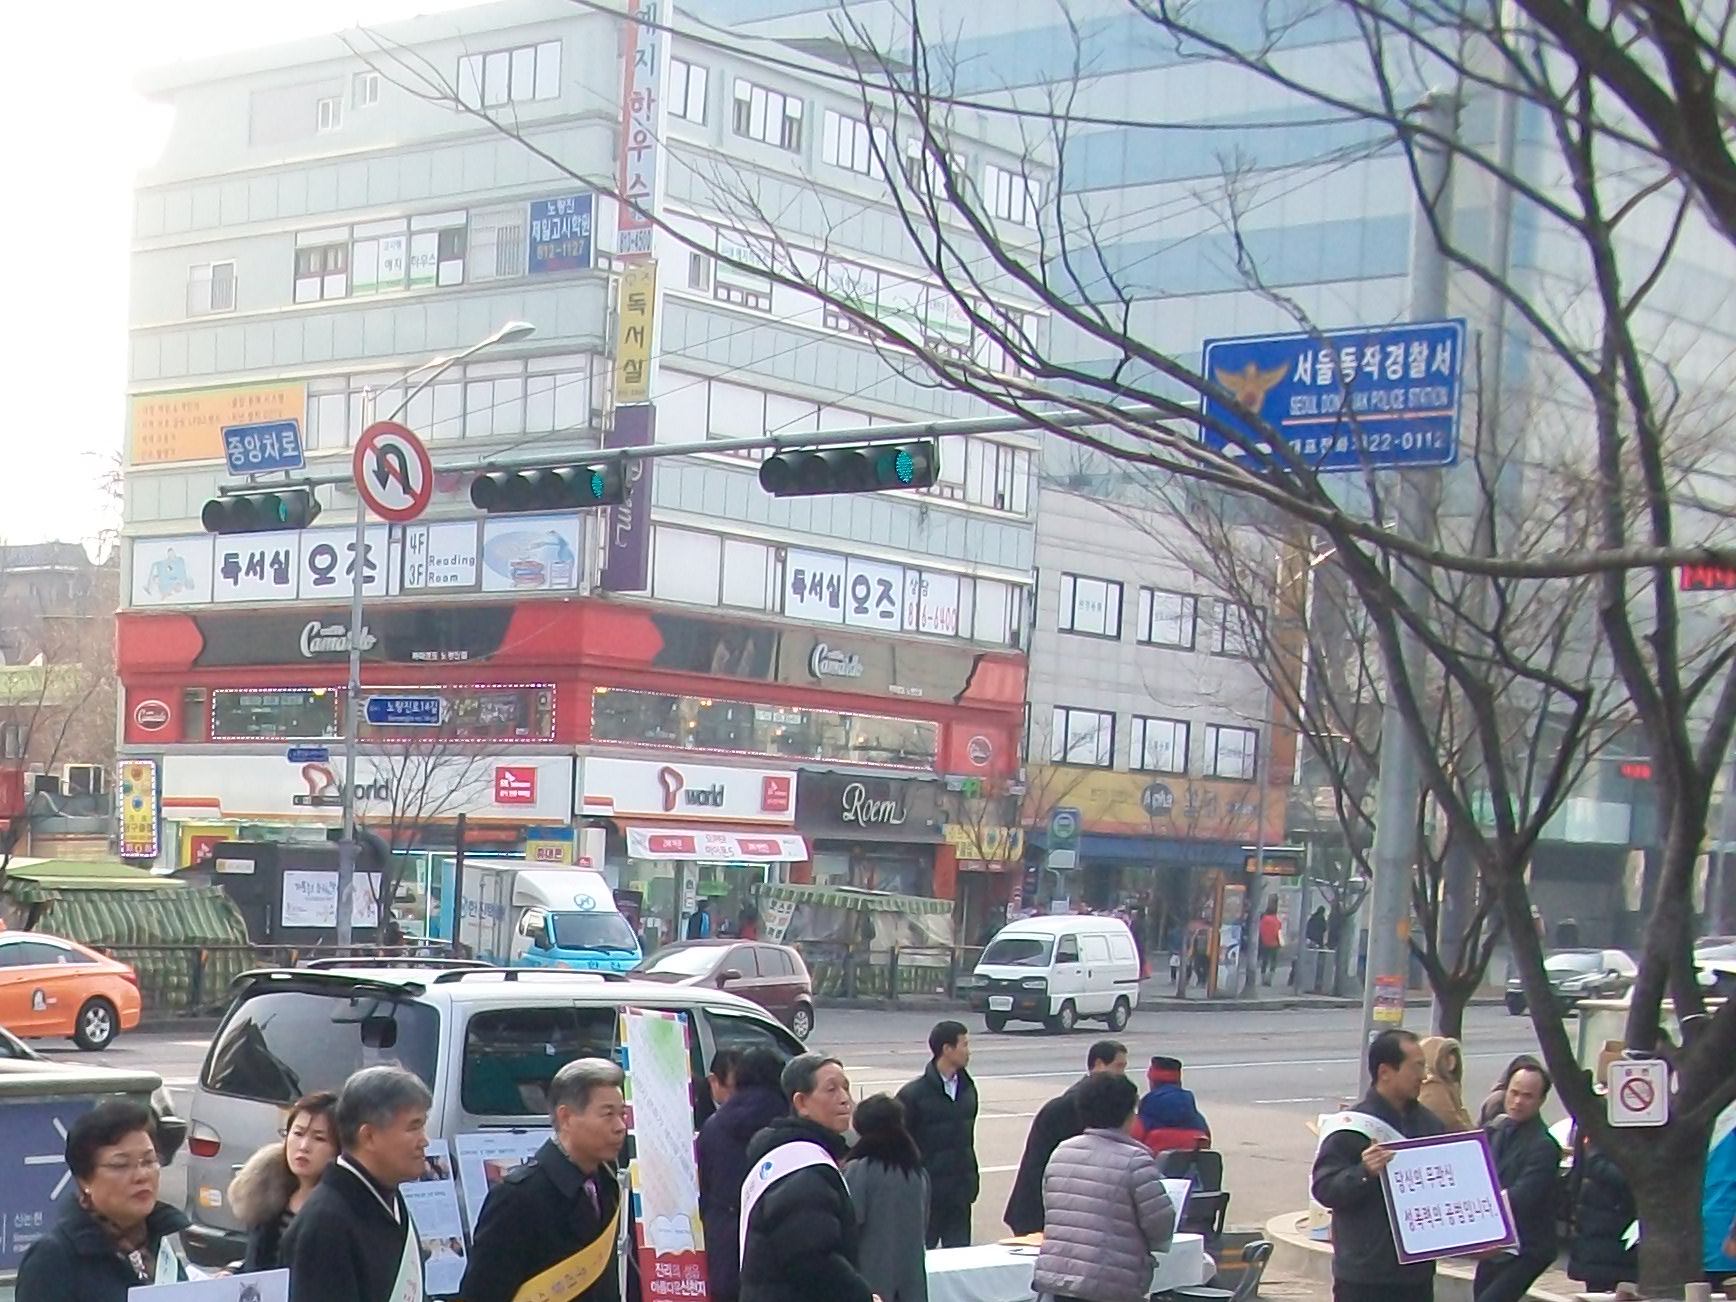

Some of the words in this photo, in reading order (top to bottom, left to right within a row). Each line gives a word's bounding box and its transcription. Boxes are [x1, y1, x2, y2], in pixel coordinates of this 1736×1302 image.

[623, 292, 646, 384] 독서실
[227, 431, 300, 466] 중앙차로
[220, 550, 291, 587] 독서실
[427, 555, 476, 569] Reading
[427, 571, 460, 584] Room
[791, 568, 842, 609] 독서실
[851, 574, 897, 619] 오즈
[685, 783, 725, 808] world
[842, 782, 907, 828] Roem
